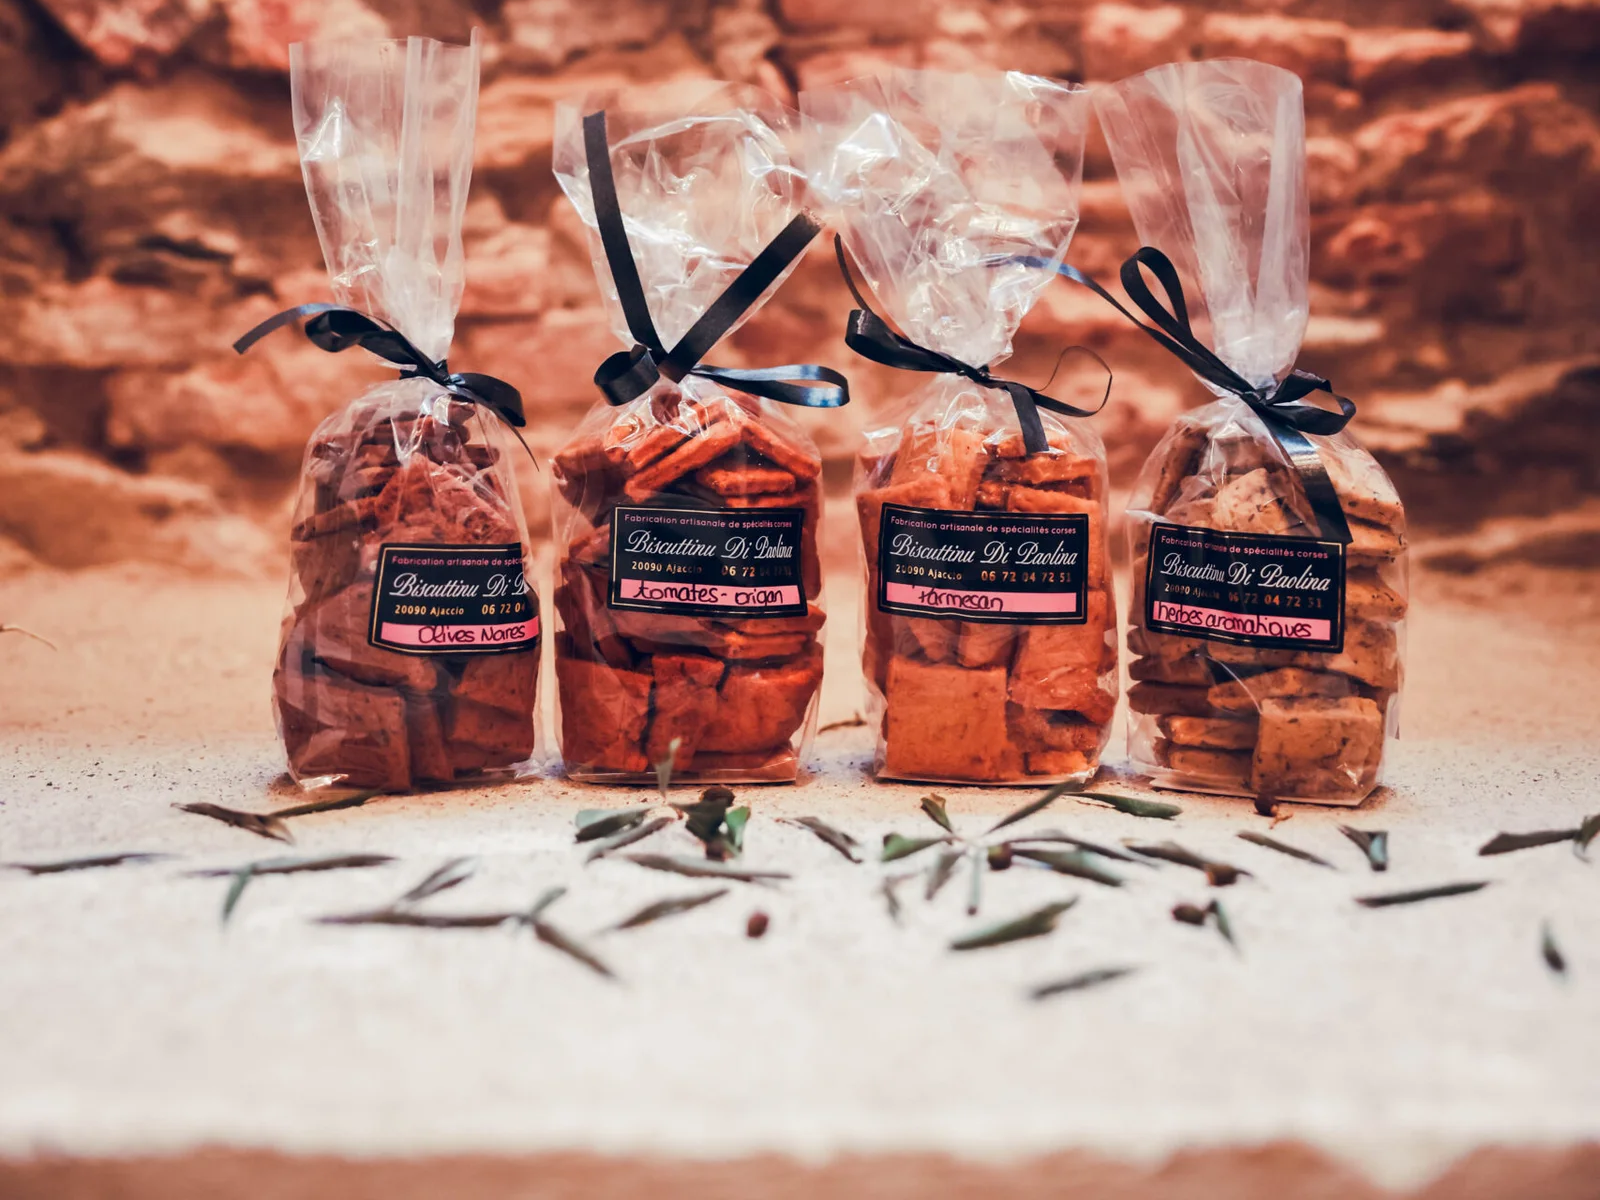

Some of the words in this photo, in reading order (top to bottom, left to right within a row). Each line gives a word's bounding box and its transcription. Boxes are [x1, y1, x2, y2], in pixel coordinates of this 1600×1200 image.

[624, 513, 678, 524] Fabrication
[679, 517, 726, 528] artisanale
[728, 520, 740, 529] de
[890, 515, 938, 530] Fabrication
[940, 523, 984, 532] artisanale
[986, 524, 998, 533] de
[1001, 525, 1049, 535] spécialités
[1051, 527, 1077, 535] corses
[624, 529, 717, 557] Biscuttinu
[721, 536, 753, 560] Di
[753, 533, 793, 560] Paolina
[889, 533, 976, 564] Biscuttinu
[980, 540, 1013, 564] Di
[1015, 540, 1079, 566] Paolina
[1229, 545, 1241, 554] de
[1243, 546, 1295, 557] spécialités
[1297, 550, 1328, 559] corses
[392, 556, 444, 566] Fabrication
[447, 556, 489, 566] artisanale
[491, 557, 502, 566] de
[631, 561, 663, 572] 20090
[722, 565, 736, 576] 06
[742, 566, 755, 577] 72
[896, 564, 925, 576] 20090
[928, 568, 963, 581] Ajaccio
[981, 570, 996, 582] 06
[1002, 571, 1017, 583] 72
[1023, 572, 1036, 583] 04
[1042, 572, 1055, 583] 72
[1059, 572, 1071, 583] 51
[1160, 552, 1225, 583] Biscuttinu
[1227, 561, 1256, 586] Di
[1257, 563, 1332, 592] Paolina
[389, 572, 480, 598] Biscuttinu
[482, 573, 512, 598] Di
[735, 588, 783, 606] origan
[1264, 594, 1280, 606] 04
[1287, 595, 1301, 608] 72
[394, 604, 427, 615] 20090
[429, 605, 465, 617] Ajaccio
[481, 603, 495, 615] 06
[500, 603, 511, 614] 72
[418, 625, 475, 644] Olives
